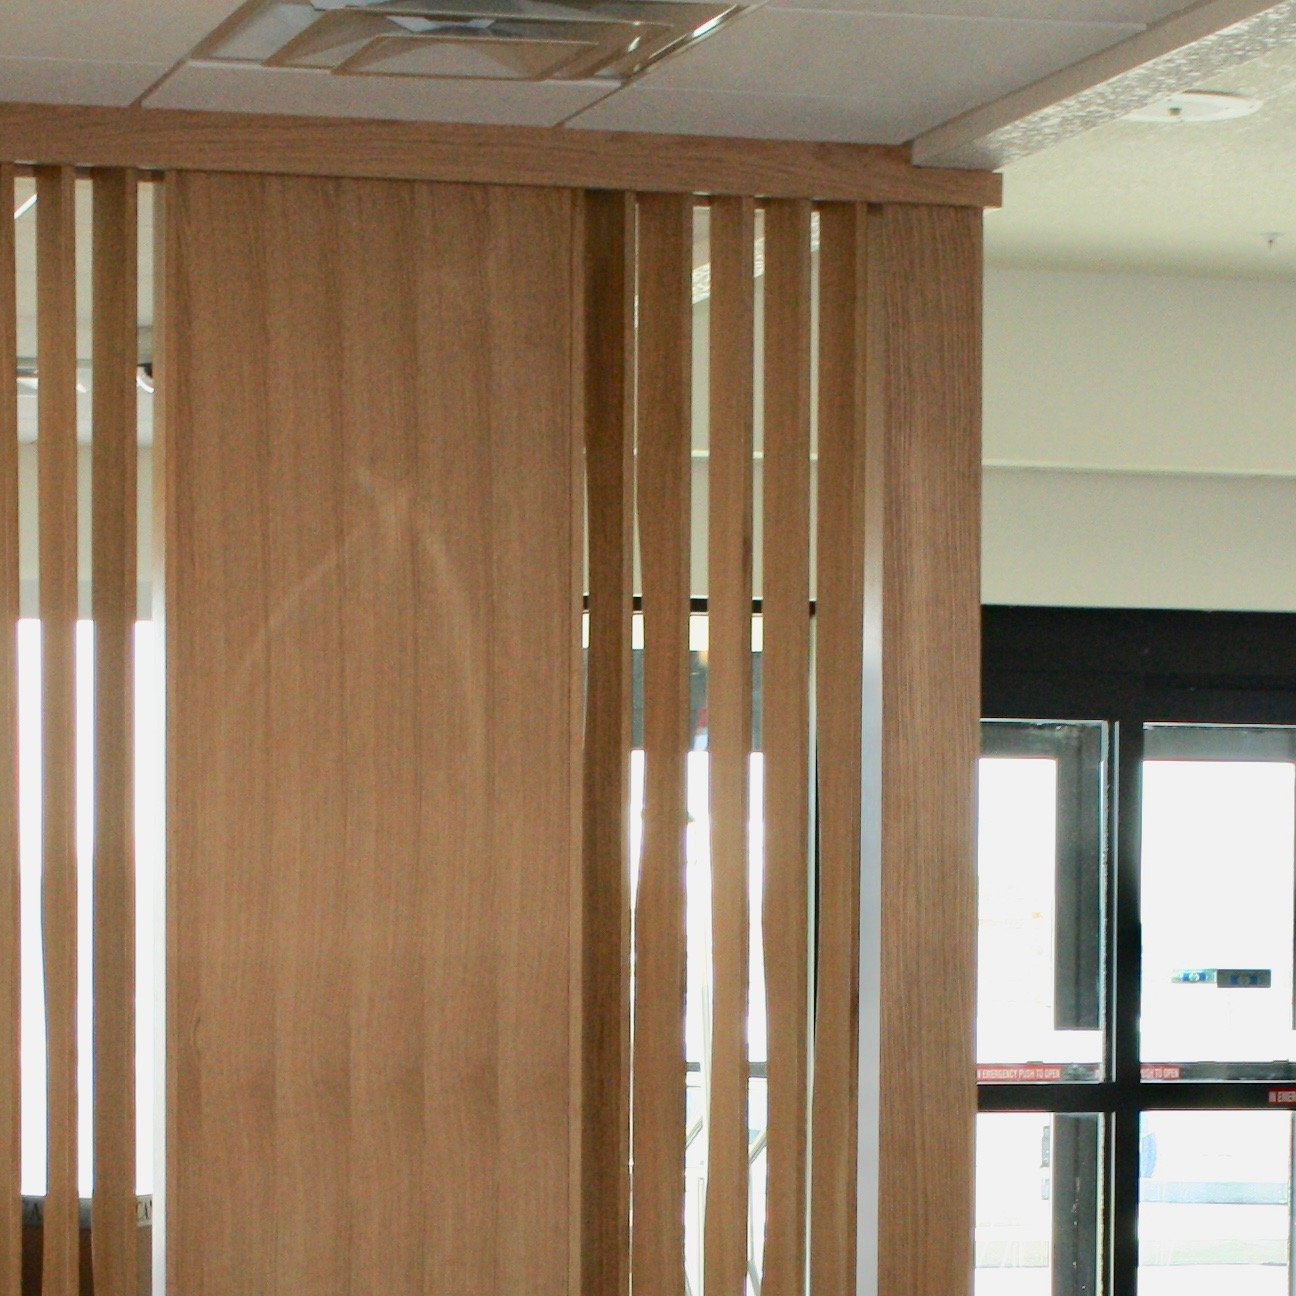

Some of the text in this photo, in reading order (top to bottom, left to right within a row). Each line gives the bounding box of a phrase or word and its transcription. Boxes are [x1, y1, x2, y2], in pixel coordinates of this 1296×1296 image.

[982, 1069, 1017, 1079] EMERGENCY
[1018, 1069, 1035, 1079] PUSH
[1036, 1069, 1044, 1079] TO
[1044, 1069, 1061, 1079] OPEN
[1154, 1068, 1163, 1078] TO
[1163, 1068, 1180, 1078] OPEN
